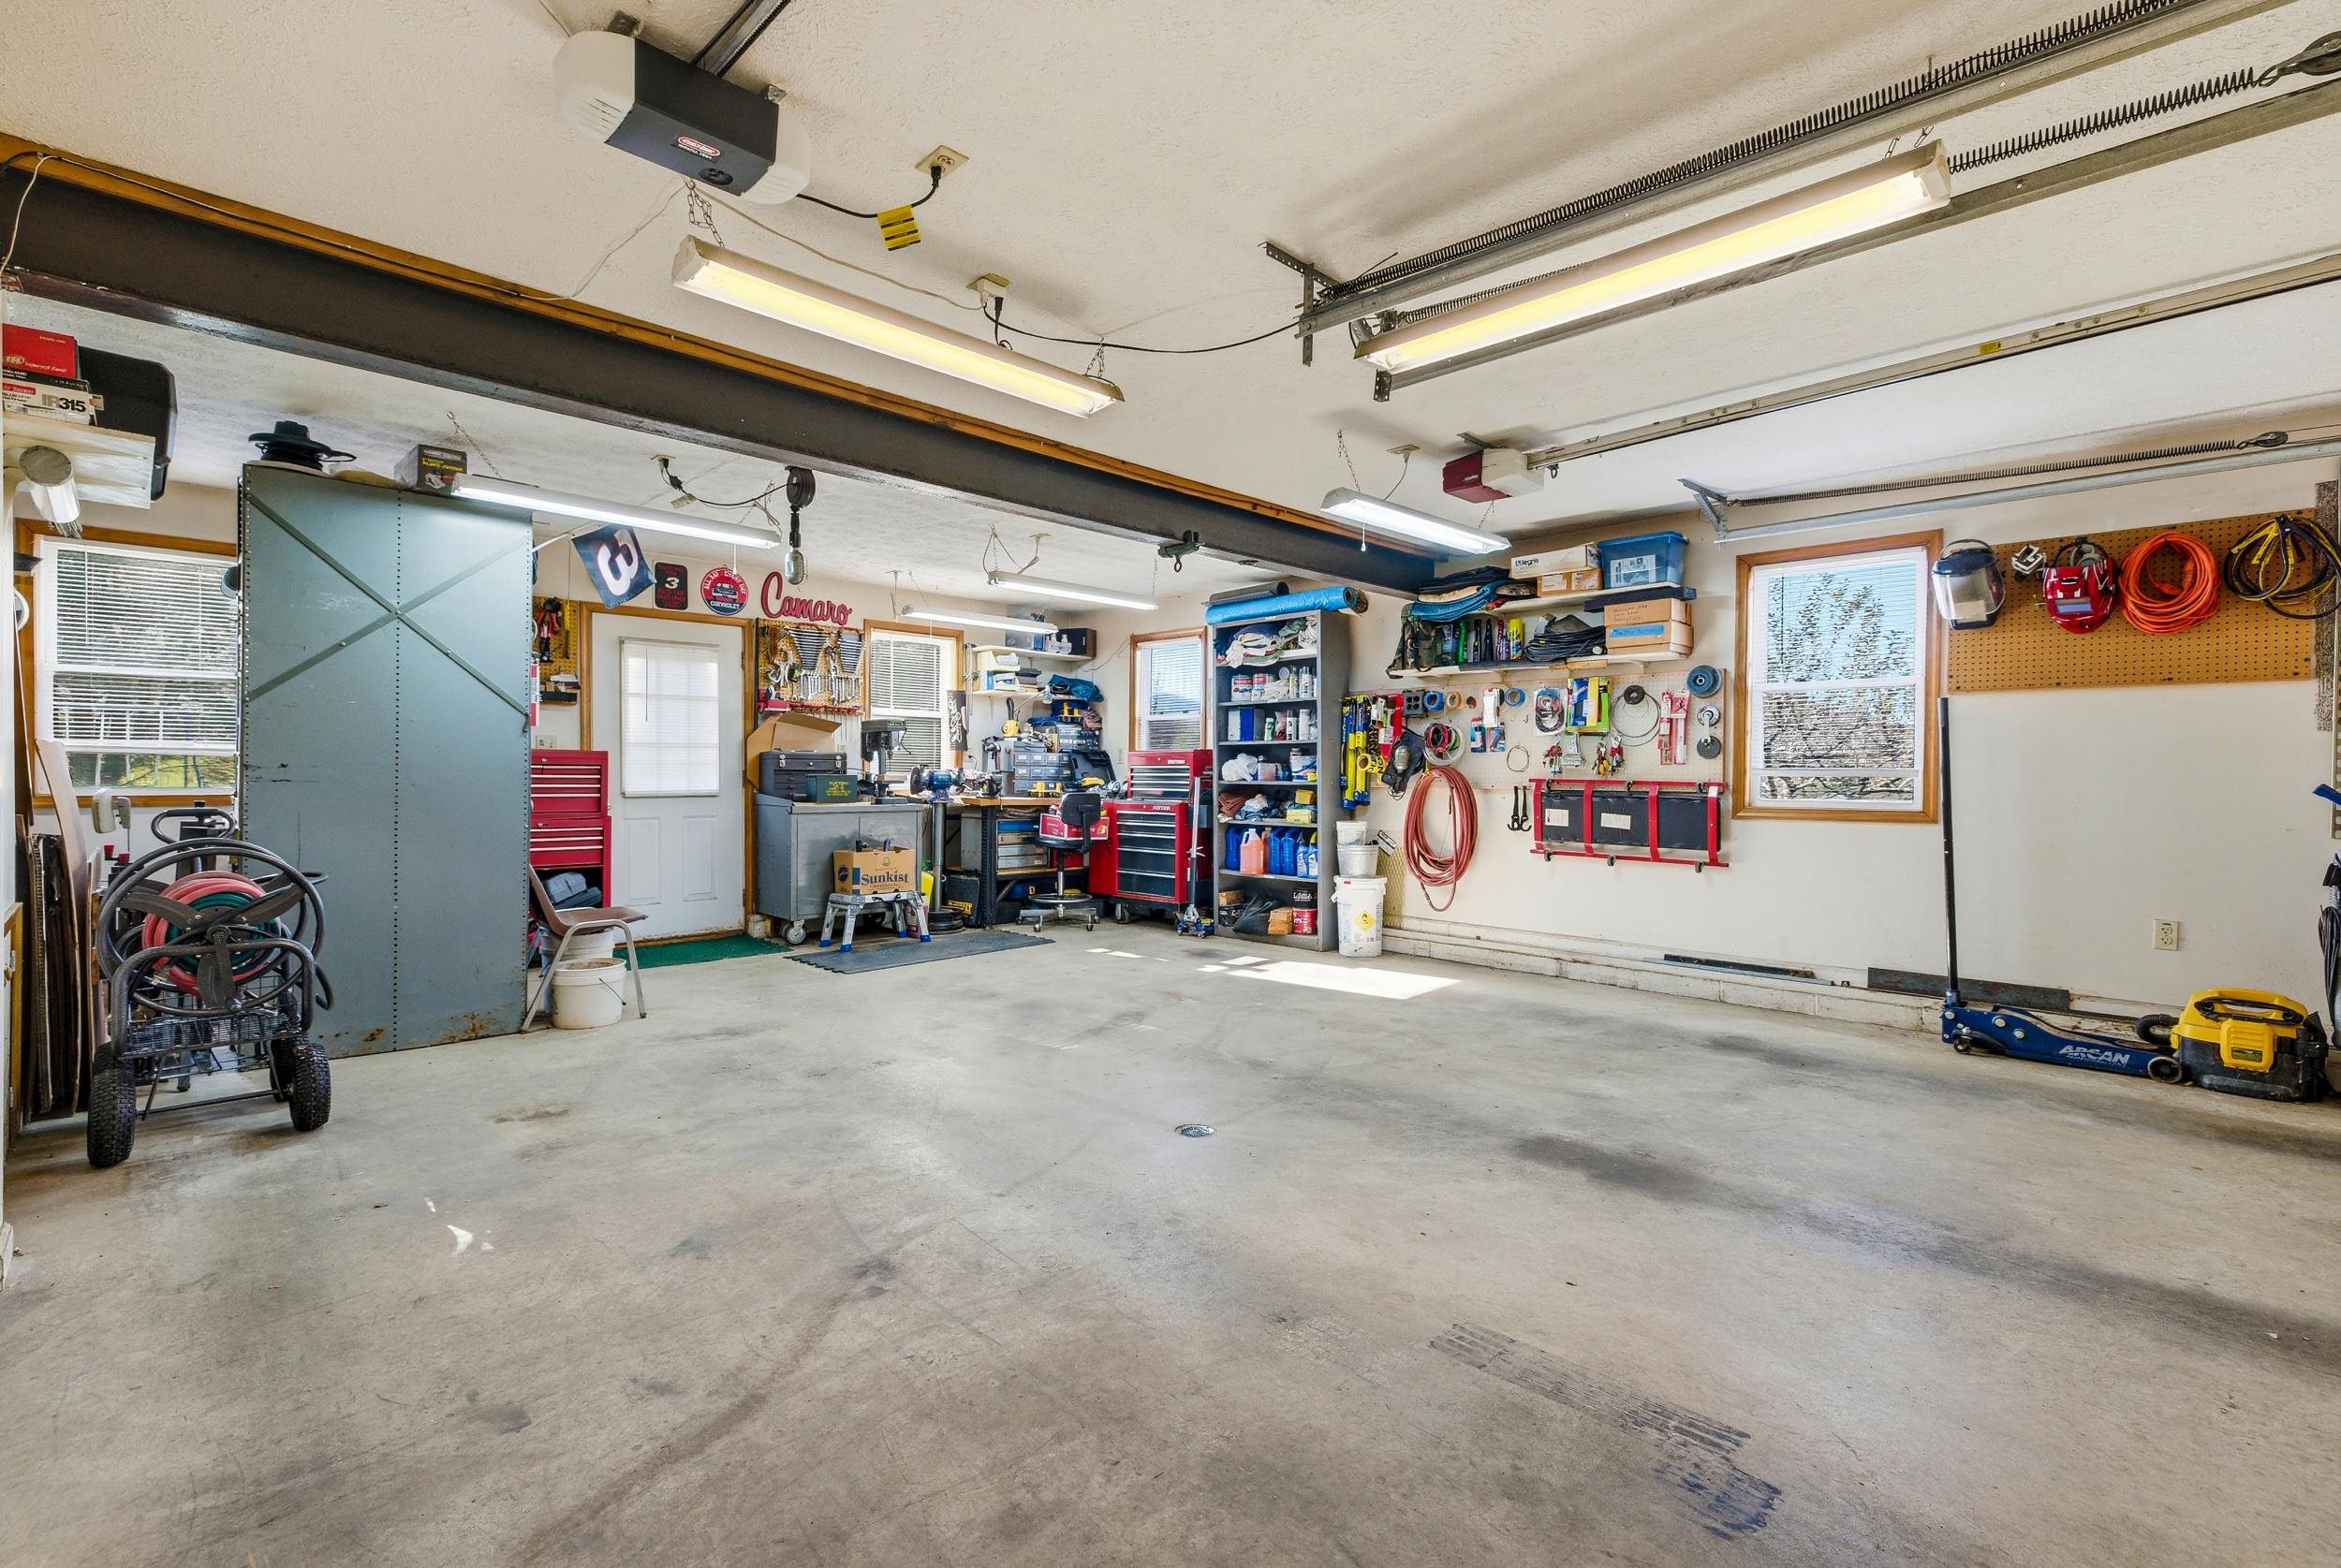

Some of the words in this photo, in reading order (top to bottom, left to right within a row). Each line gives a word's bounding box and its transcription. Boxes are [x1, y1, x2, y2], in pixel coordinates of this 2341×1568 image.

[597, 529, 639, 596] 3
[665, 577, 679, 589] 3
[761, 571, 852, 625] Camaro
[861, 871, 909, 886] Sunkist
[2059, 1045, 2130, 1064] ARCAN
